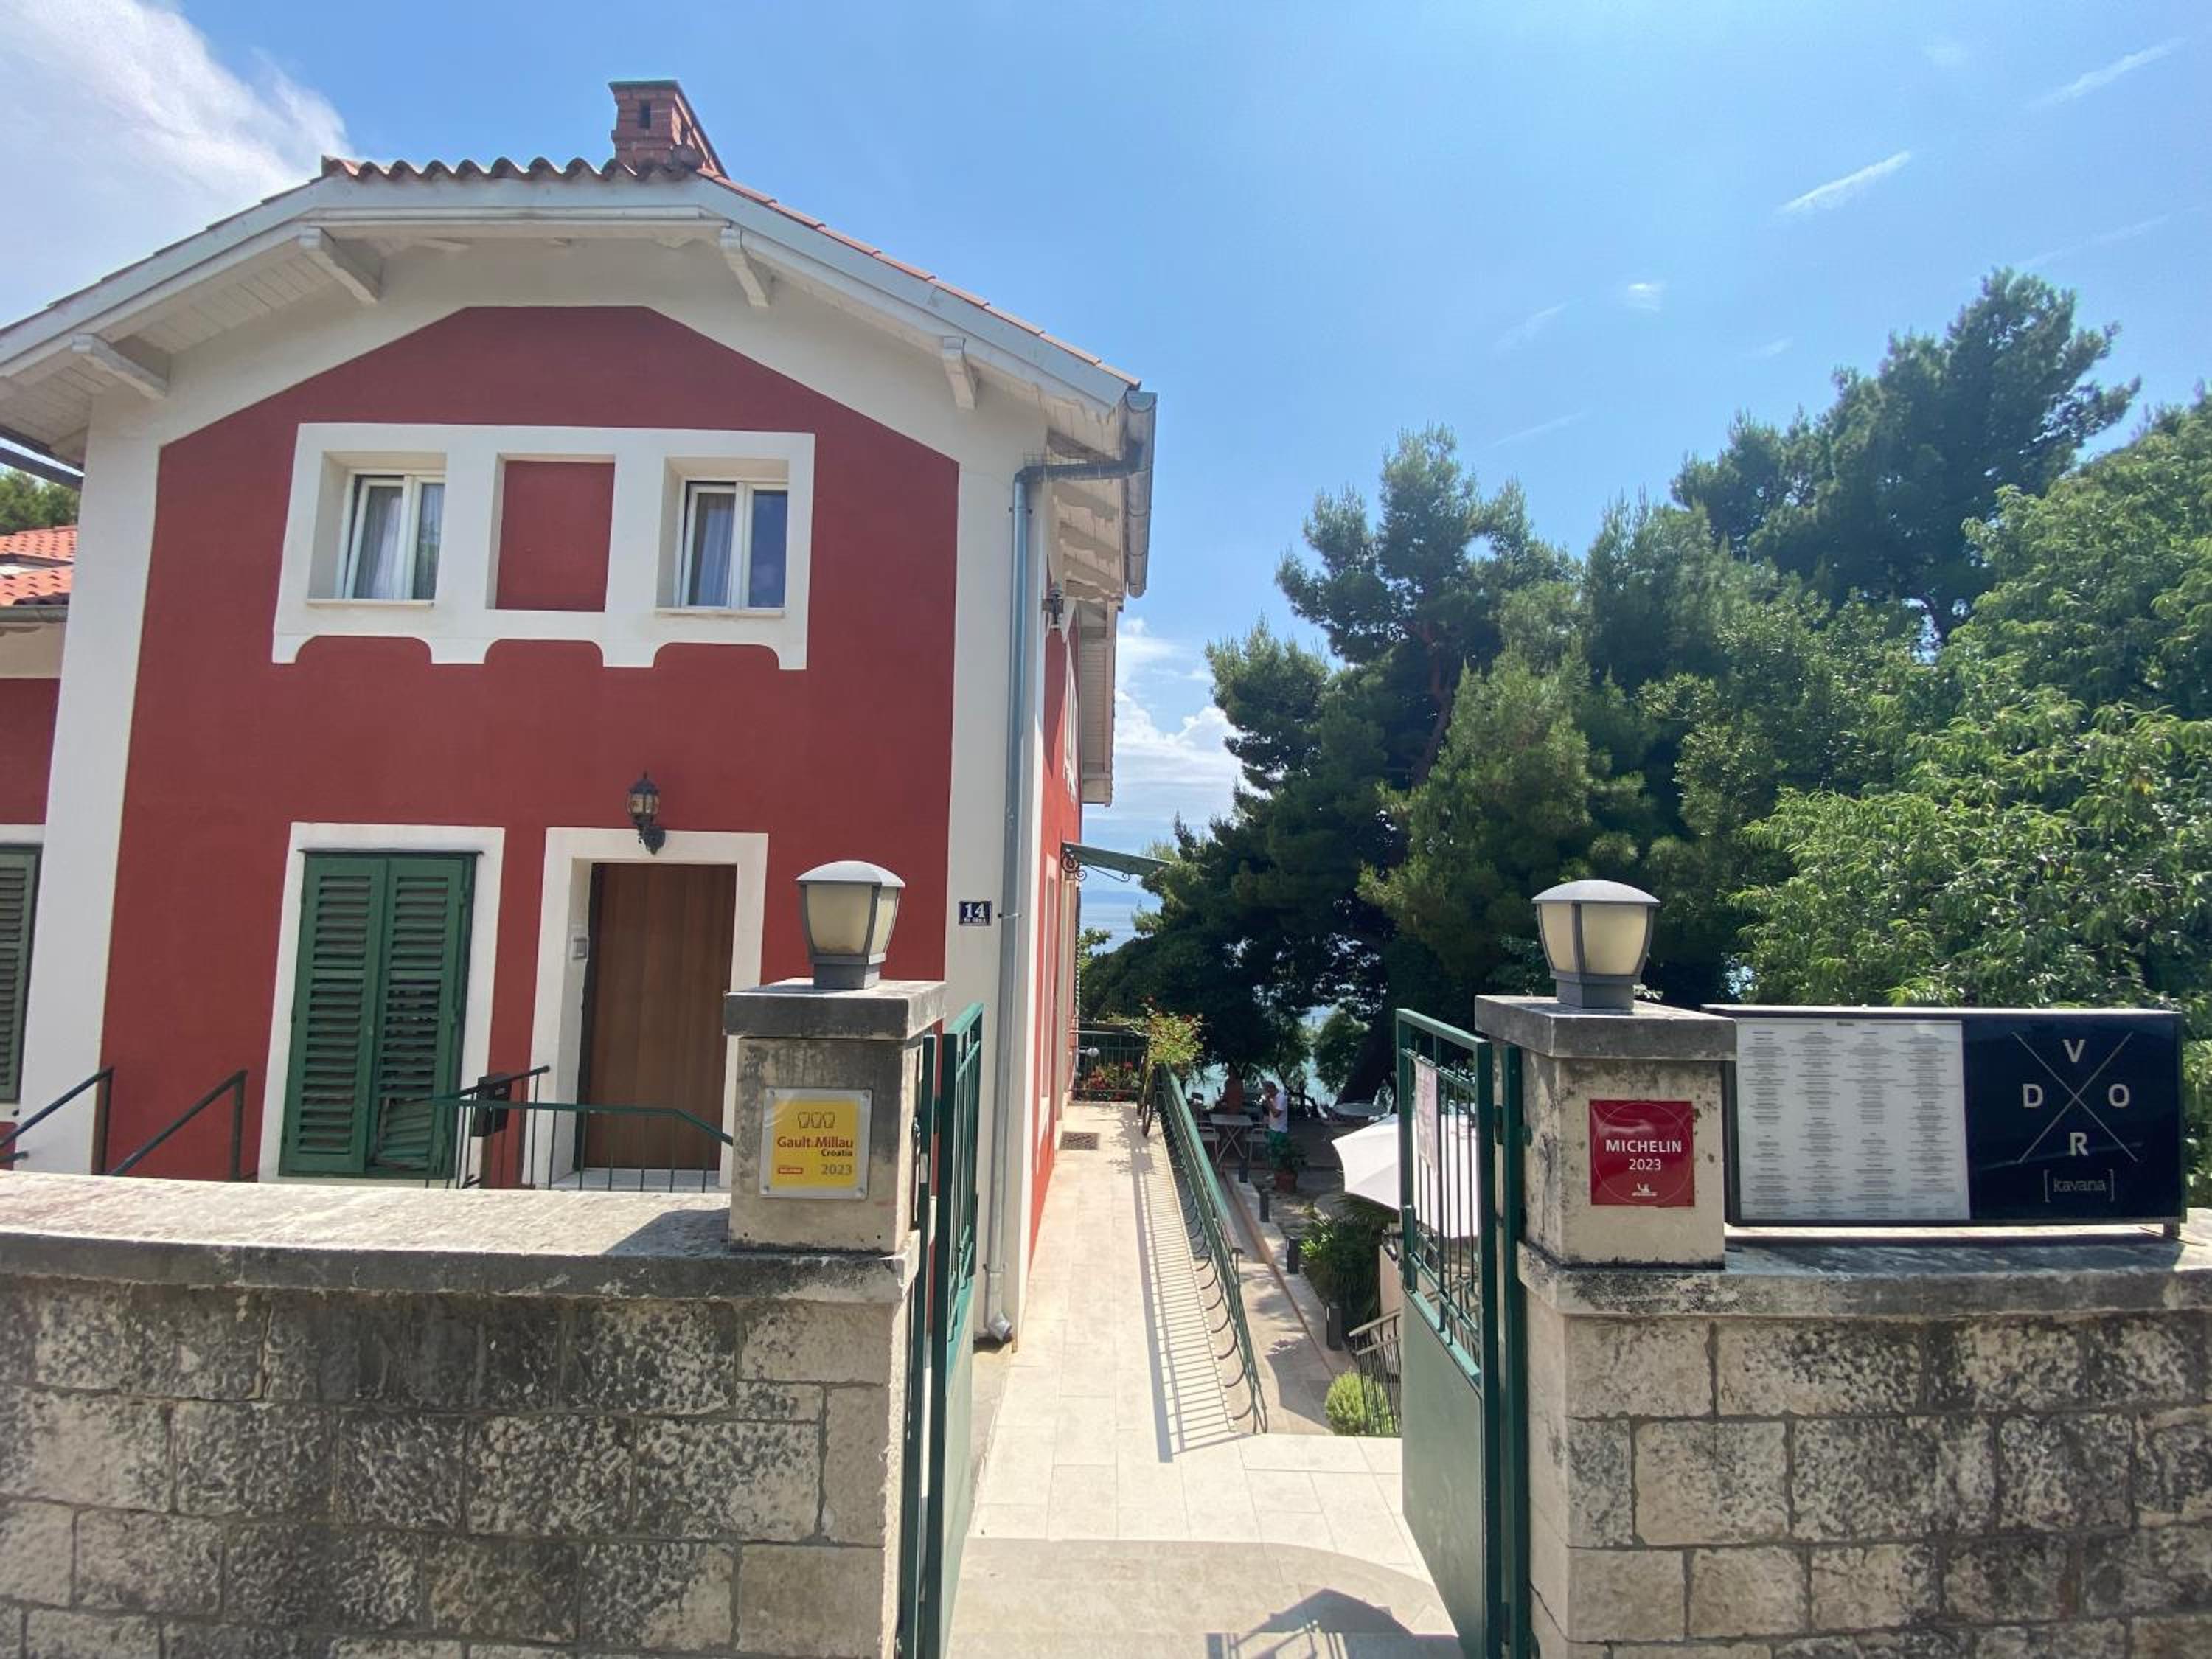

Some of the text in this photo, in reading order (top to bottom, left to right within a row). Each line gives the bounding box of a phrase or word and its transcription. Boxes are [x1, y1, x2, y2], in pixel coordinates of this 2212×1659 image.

[965, 903, 985, 919] 14
[2063, 1039, 2085, 1062] V
[776, 1135, 853, 1148] Gault Millau
[1606, 1140, 1682, 1152] MICHELIN
[2069, 1132, 2089, 1156] R
[821, 1149, 853, 1157] Croatia
[821, 1164, 852, 1175] 2023
[1628, 1158, 1662, 1171] 2023
